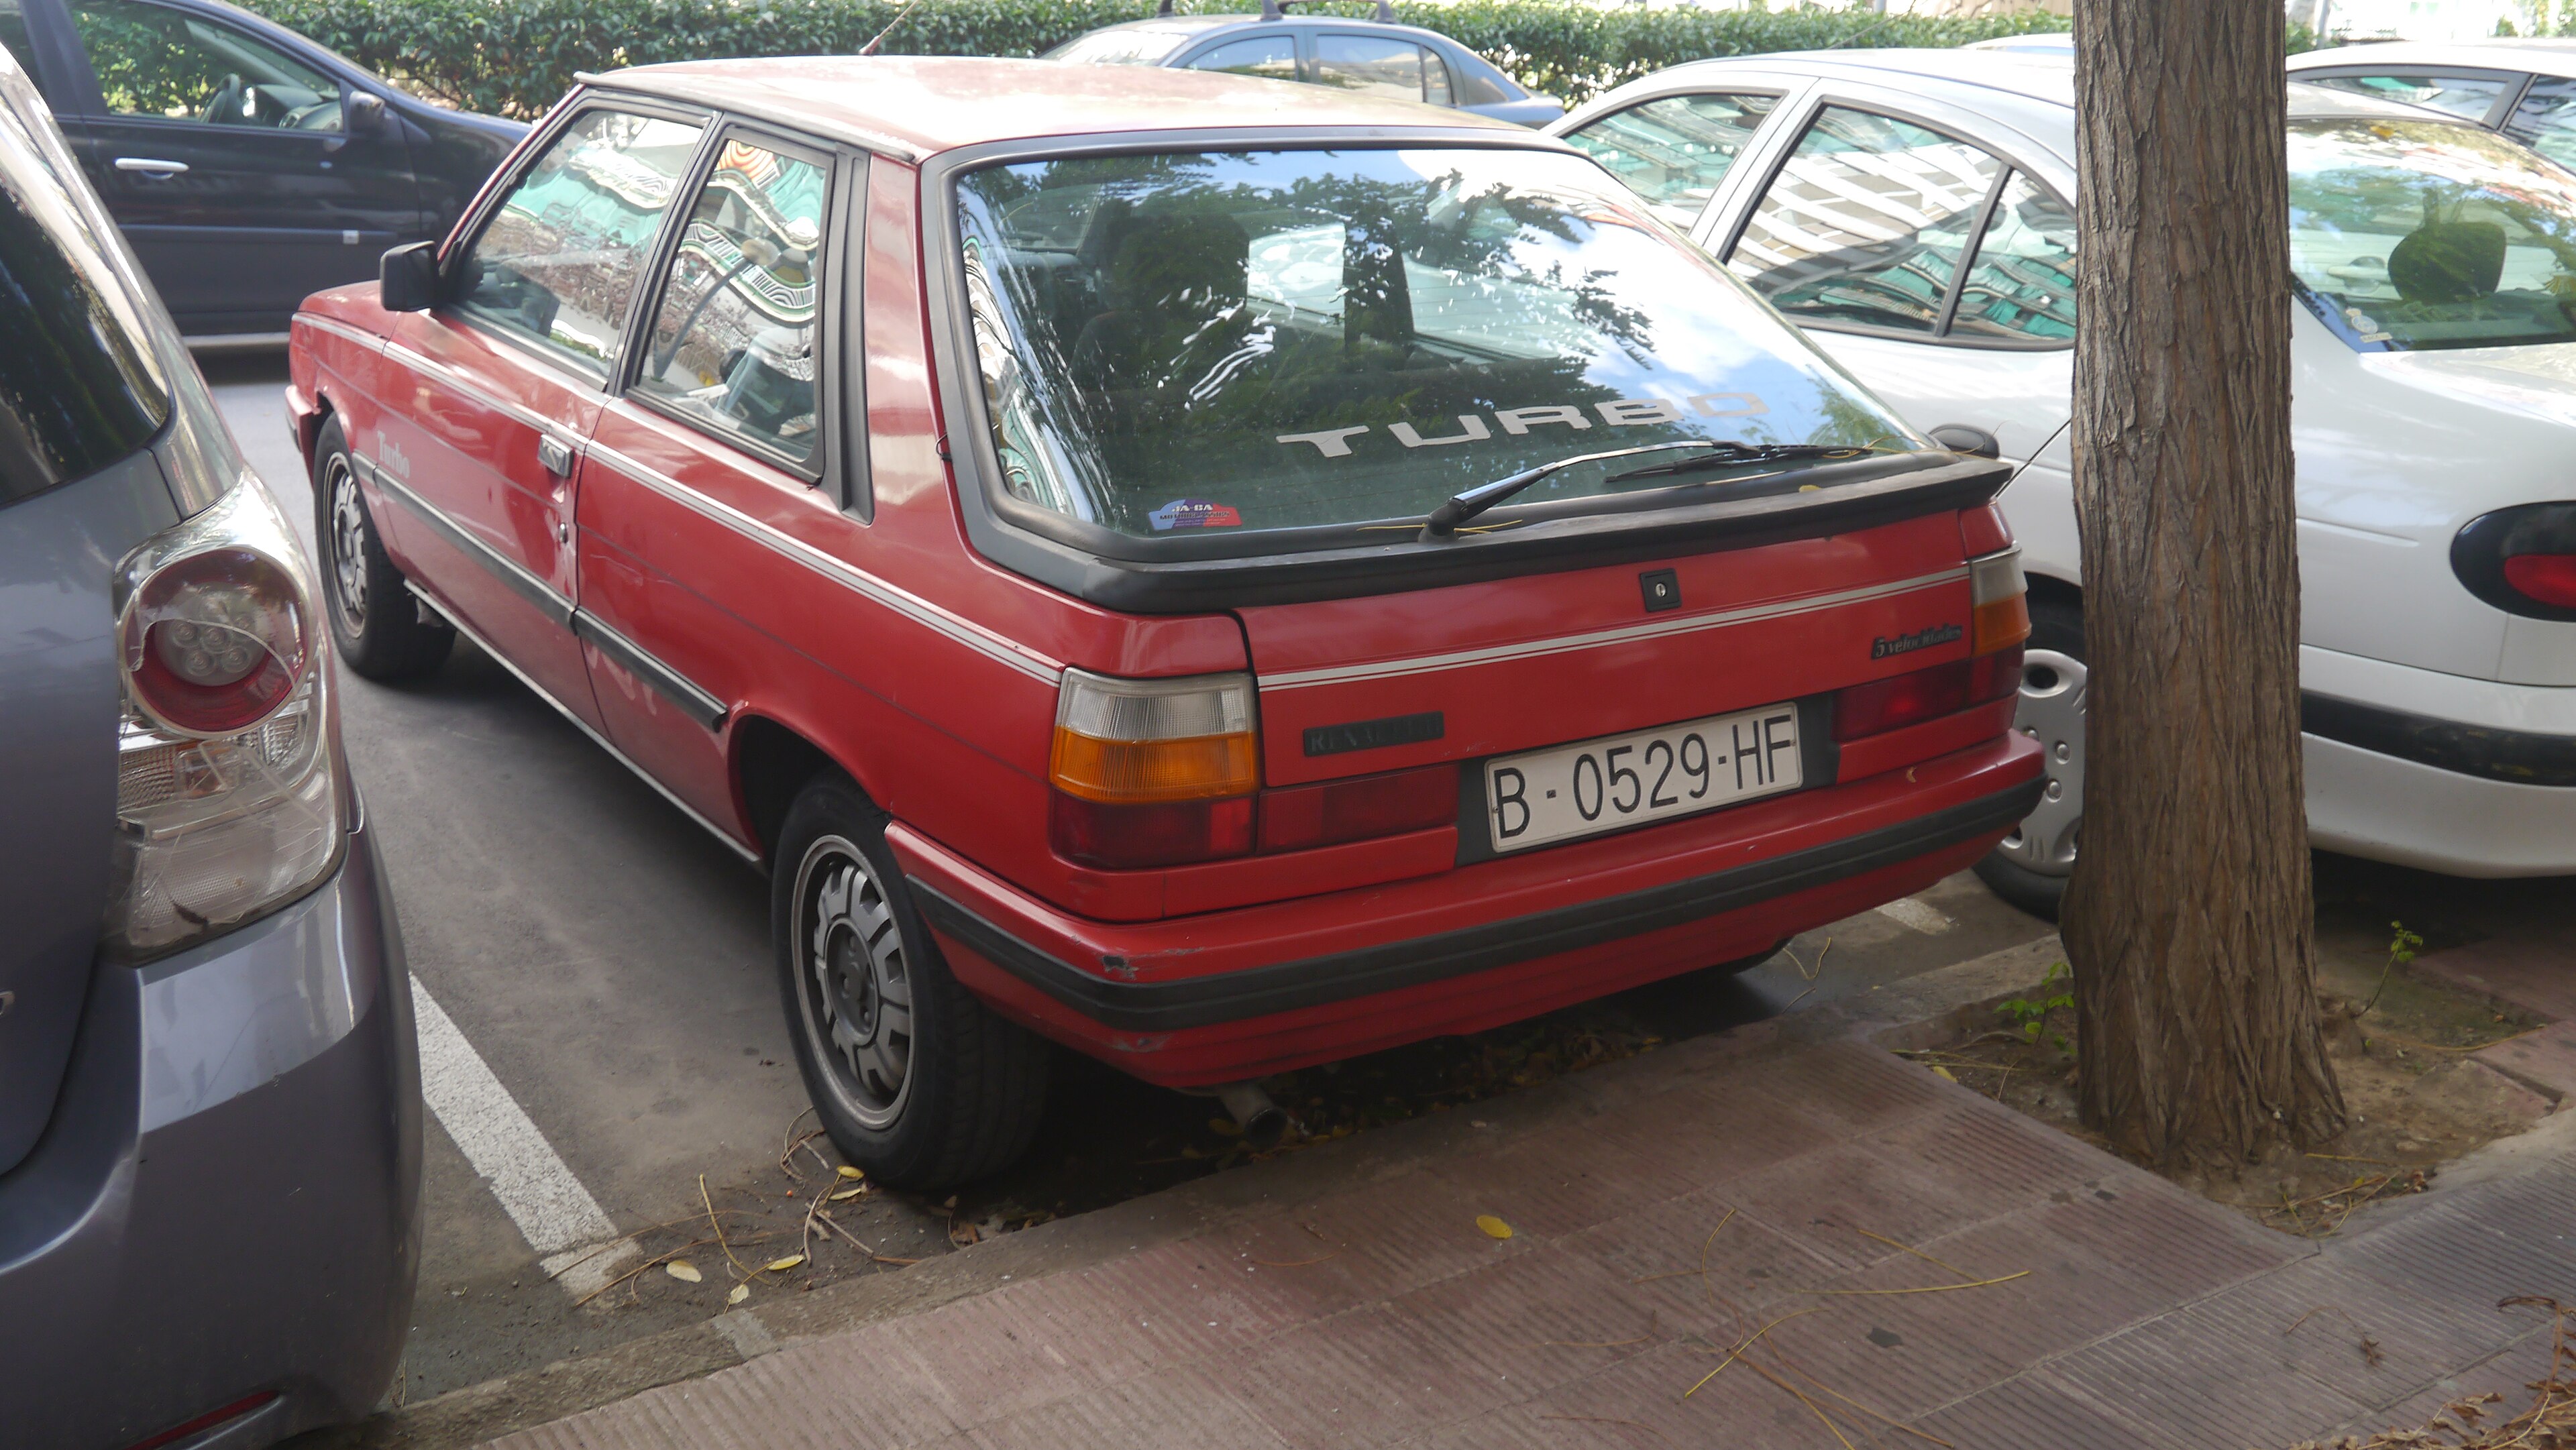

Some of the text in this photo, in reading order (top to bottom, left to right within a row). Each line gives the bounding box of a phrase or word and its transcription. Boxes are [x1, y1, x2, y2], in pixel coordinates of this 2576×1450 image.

[1275, 392, 1770, 458] TURBO
[377, 429, 410, 479] Turbo
[1875, 636, 1886, 658] 5
